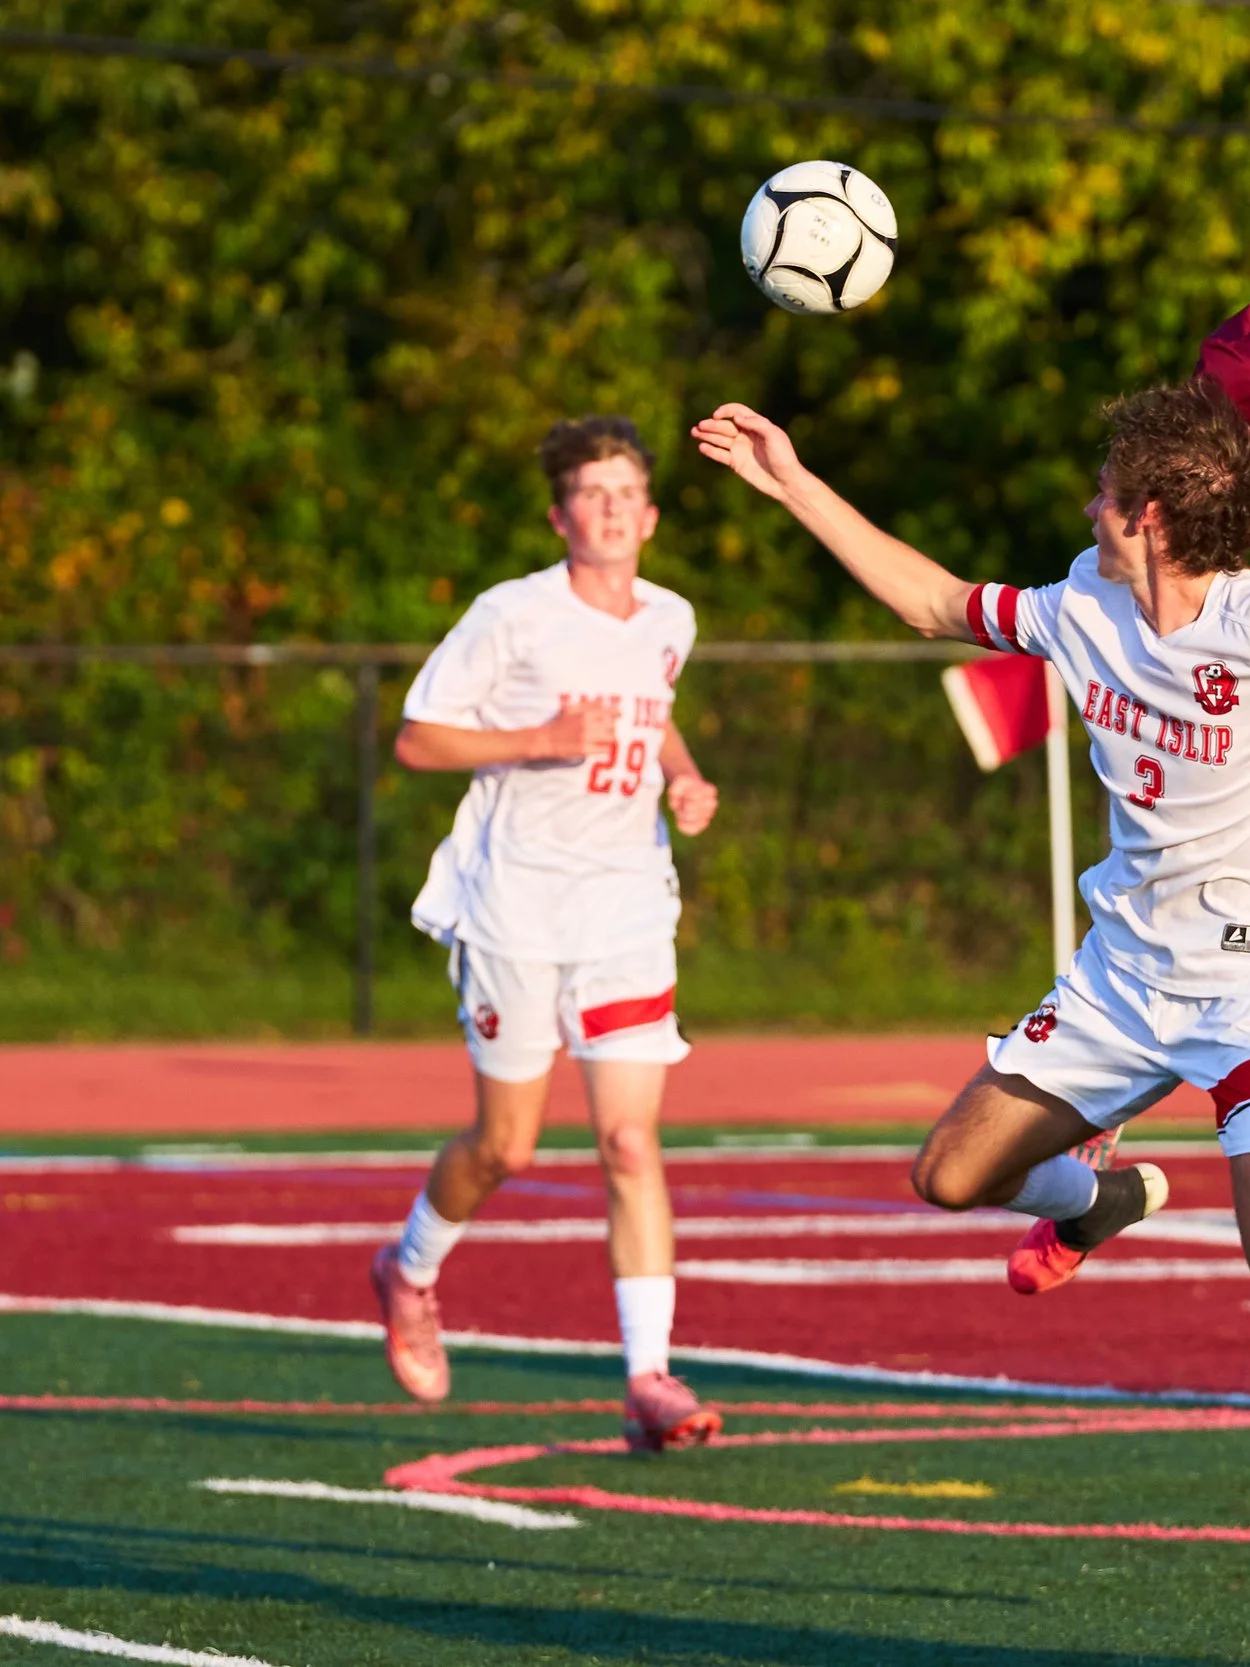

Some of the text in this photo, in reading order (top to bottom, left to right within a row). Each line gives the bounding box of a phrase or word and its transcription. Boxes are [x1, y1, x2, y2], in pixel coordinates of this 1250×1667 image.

[1082, 679, 1233, 766] EAST ISLIP
[587, 739, 646, 796] 29
[1127, 754, 1166, 812] 3
